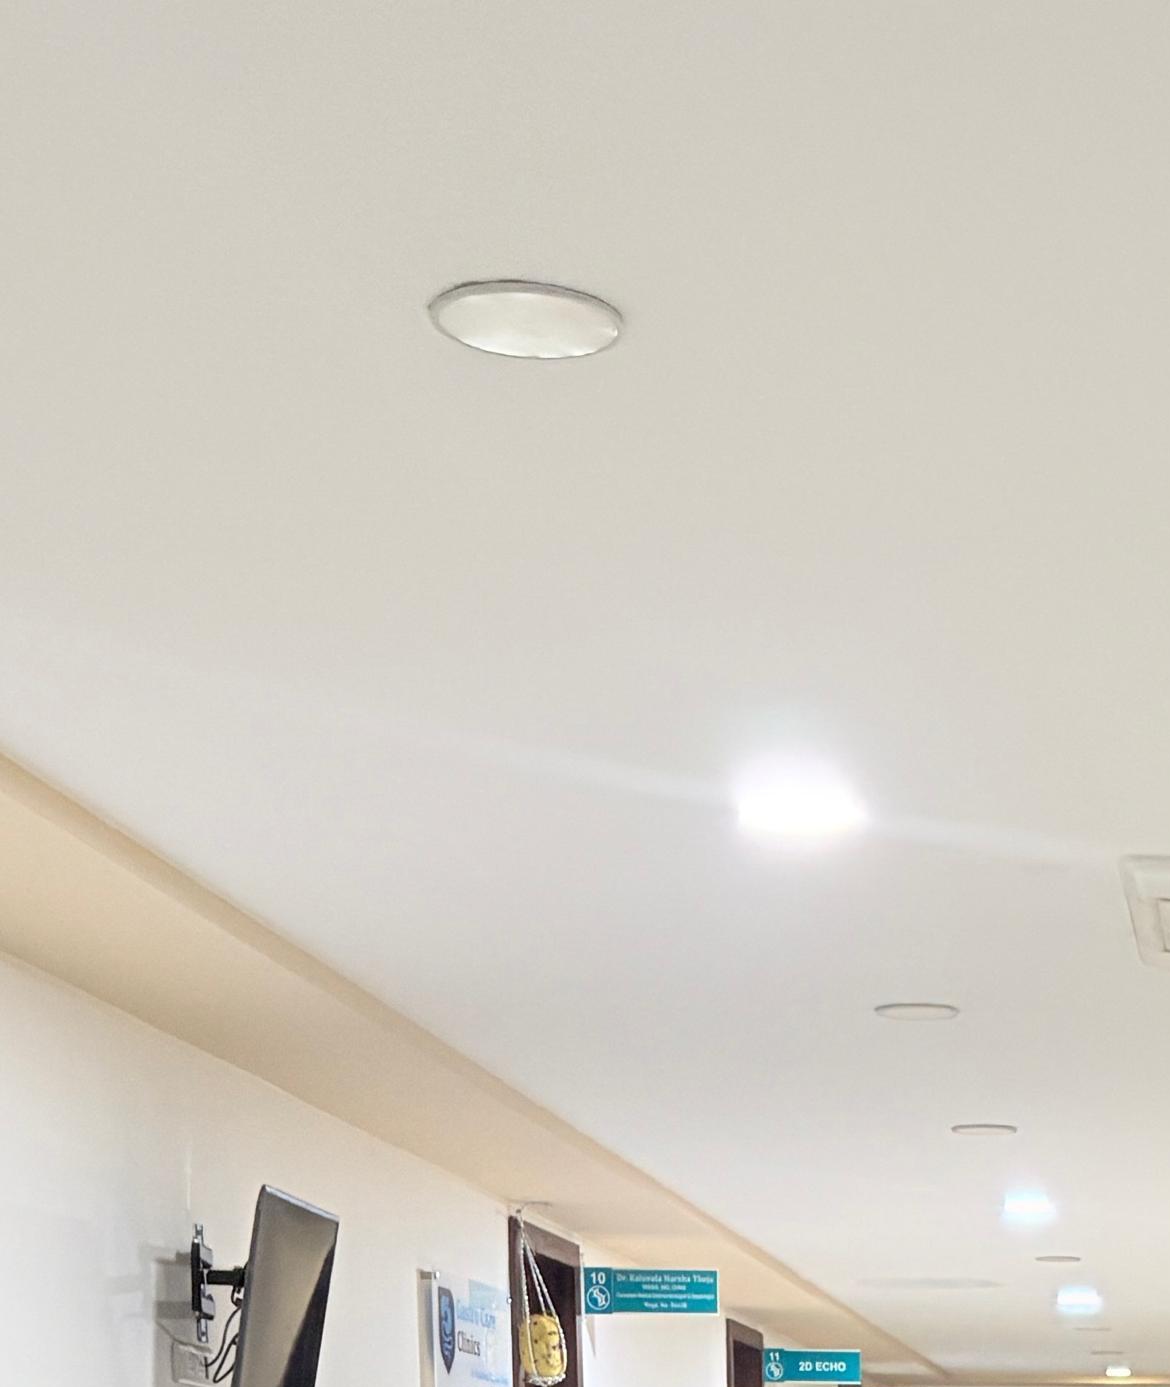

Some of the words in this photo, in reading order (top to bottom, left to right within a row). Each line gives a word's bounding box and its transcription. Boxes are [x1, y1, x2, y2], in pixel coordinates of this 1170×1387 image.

[590, 1271, 606, 1285] 10
[769, 1352, 780, 1361] 11
[798, 1361, 813, 1372] 2D
[815, 1361, 847, 1372] ECHO
